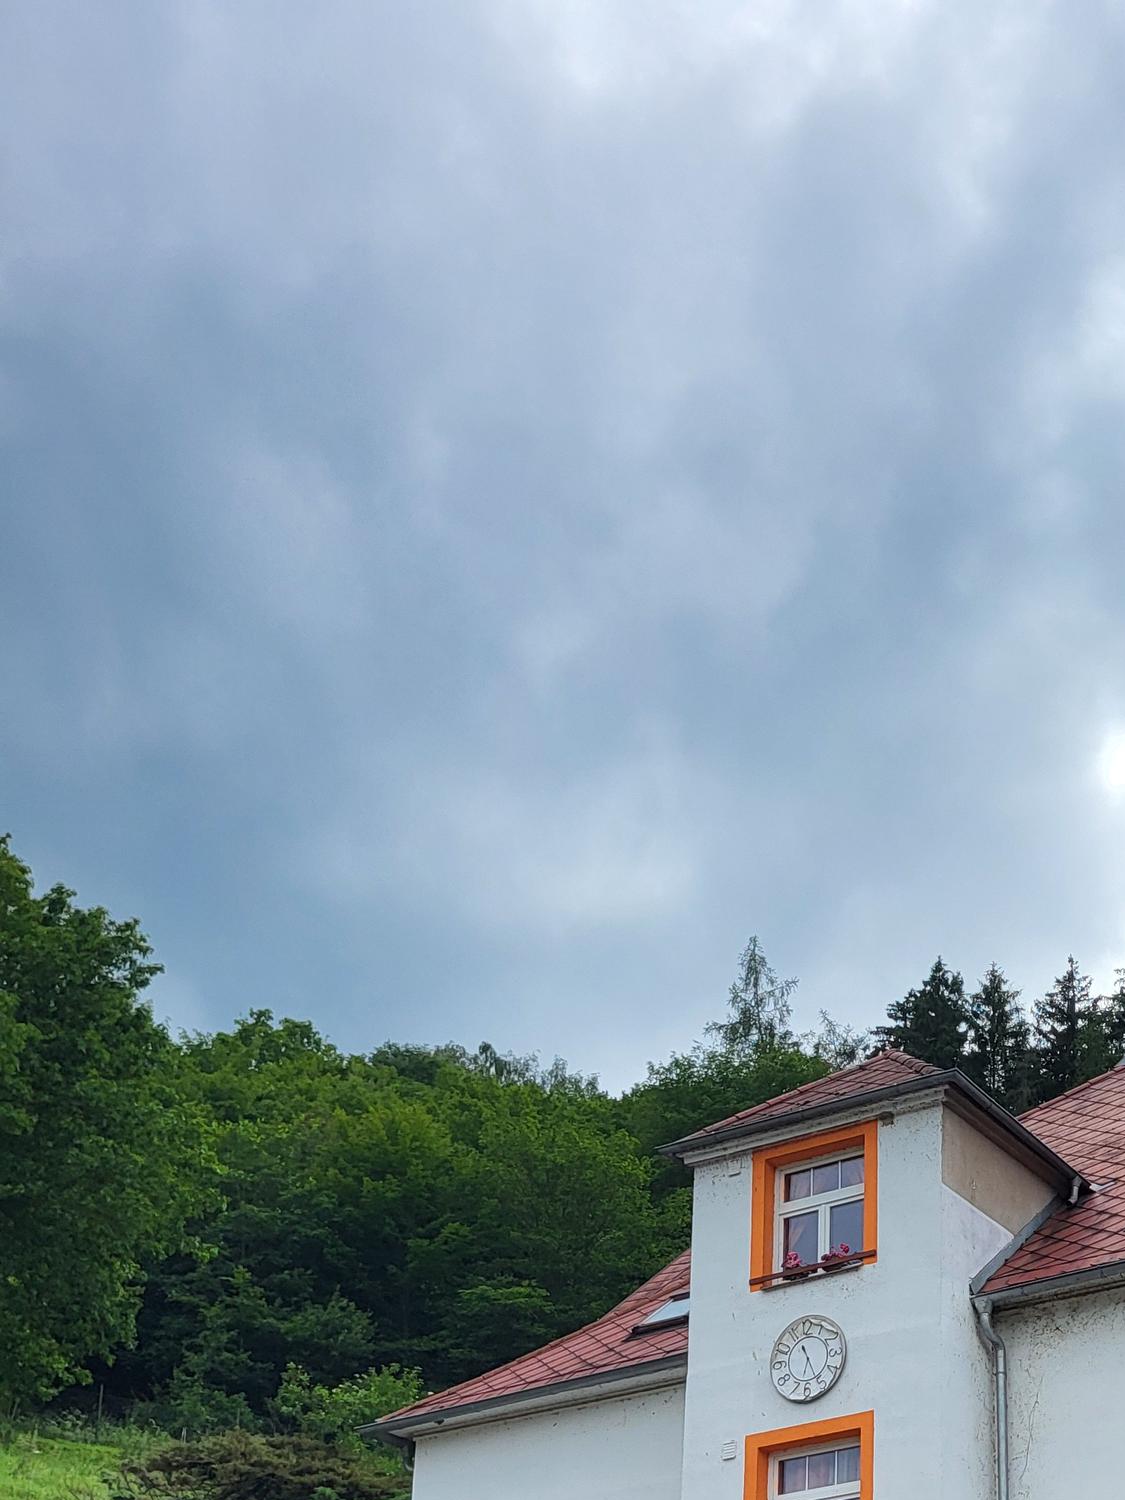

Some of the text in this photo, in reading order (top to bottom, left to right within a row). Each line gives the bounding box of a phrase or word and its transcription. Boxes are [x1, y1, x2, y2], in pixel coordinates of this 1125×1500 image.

[802, 1318, 813, 1335] 12
[824, 1331, 839, 1346] 2
[775, 1342, 791, 1358] 10
[829, 1347, 843, 1358] 3
[772, 1360, 787, 1371] 9
[777, 1373, 791, 1386] 8
[816, 1375, 827, 1390] 5
[788, 1381, 800, 1396] 7
[803, 1381, 812, 1400] 6
